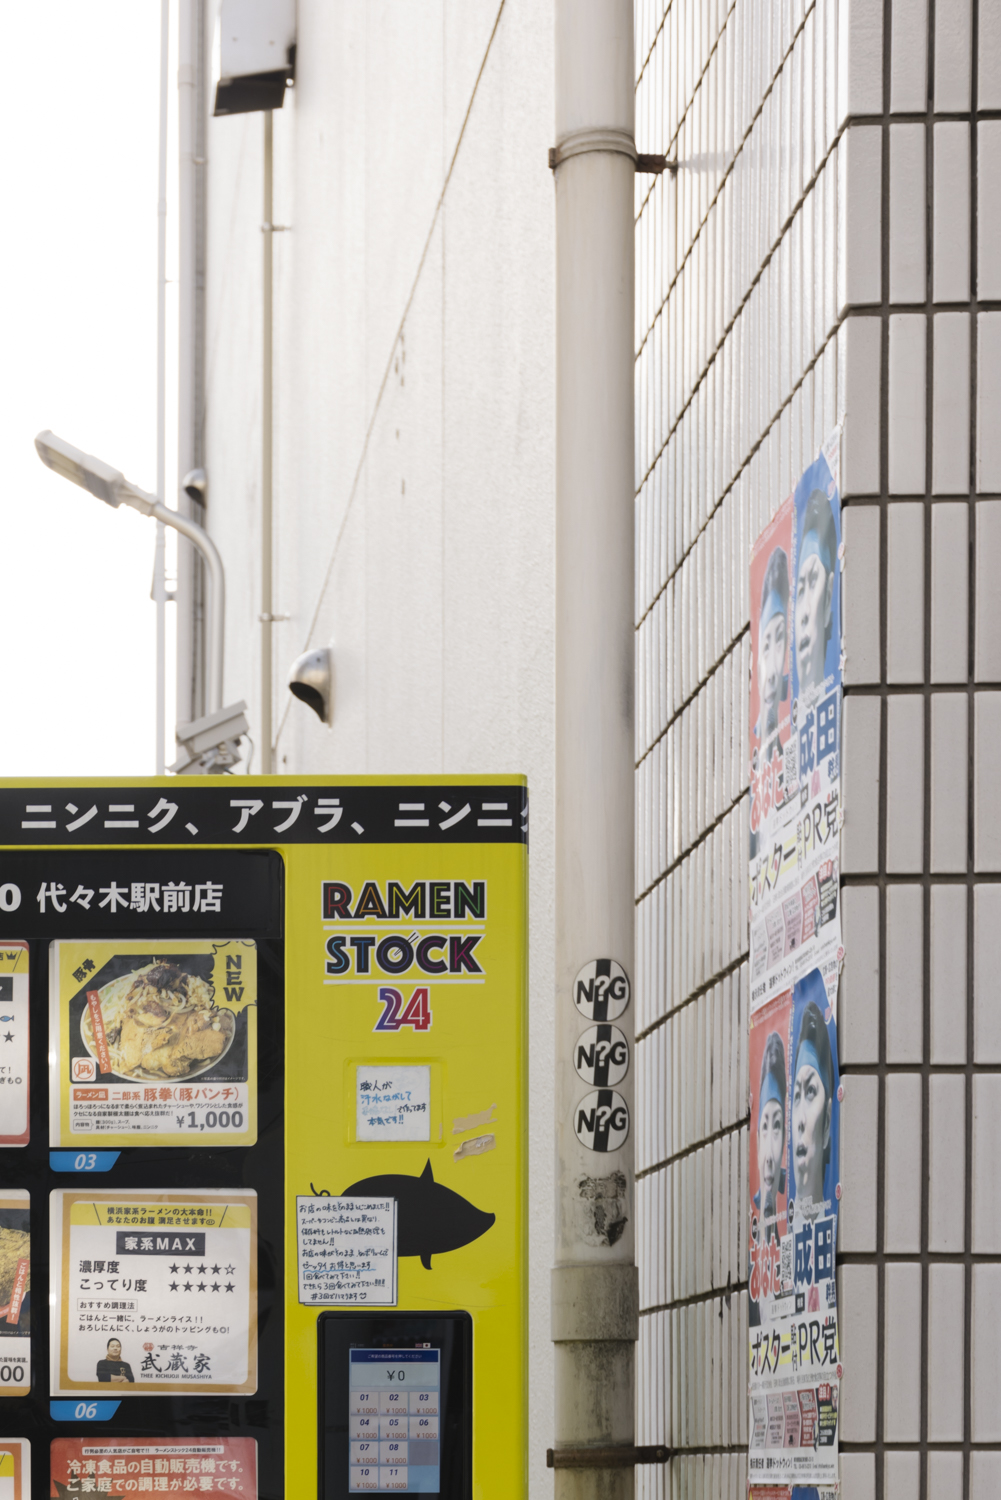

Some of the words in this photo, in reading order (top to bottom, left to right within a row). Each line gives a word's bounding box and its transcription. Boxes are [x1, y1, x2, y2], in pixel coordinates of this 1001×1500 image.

[36, 881, 225, 914] 代々木駅前店
[321, 880, 487, 920] RAMEN
[325, 932, 486, 975] STOCK
[72, 958, 96, 983] 豚骨
[223, 955, 244, 1001] NEW
[372, 986, 433, 1032] 24
[112, 1091, 141, 1101] 二郎系
[176, 1112, 243, 1130] ¥1,000
[74, 1154, 97, 1170] 03
[125, 1237, 196, 1250] 家系MAX
[79, 1260, 120, 1274] 濃厚度
[79, 1278, 148, 1292] こってり度
[140, 1352, 211, 1373] 武蔵家
[387, 1370, 405, 1381] ¥0
[75, 1403, 97, 1419] 06
[67, 1459, 244, 1474] 冷凍食品の自動販売機です。
[67, 1477, 244, 1492] ご家庭での調理が必要です。
